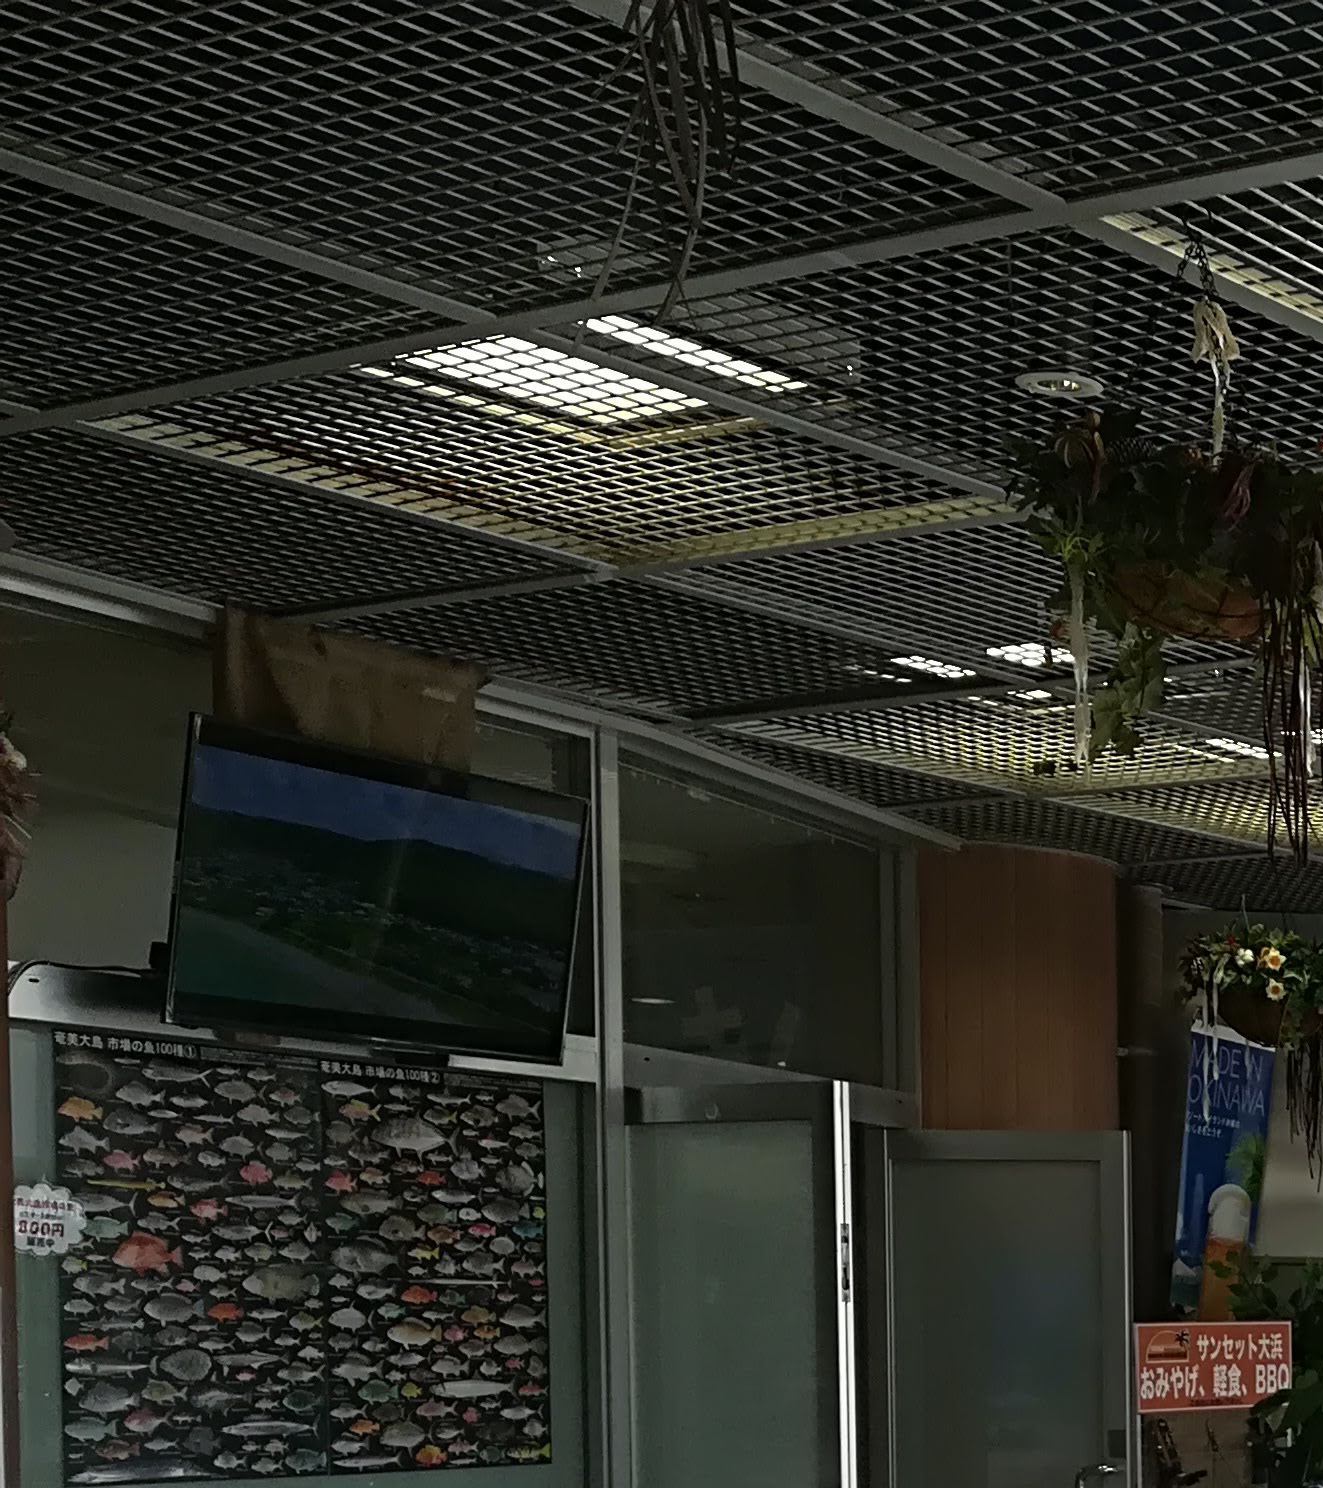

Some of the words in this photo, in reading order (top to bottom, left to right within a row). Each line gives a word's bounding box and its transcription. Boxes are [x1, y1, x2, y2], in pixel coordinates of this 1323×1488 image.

[1196, 1332, 1283, 1362] サンセット大浜
